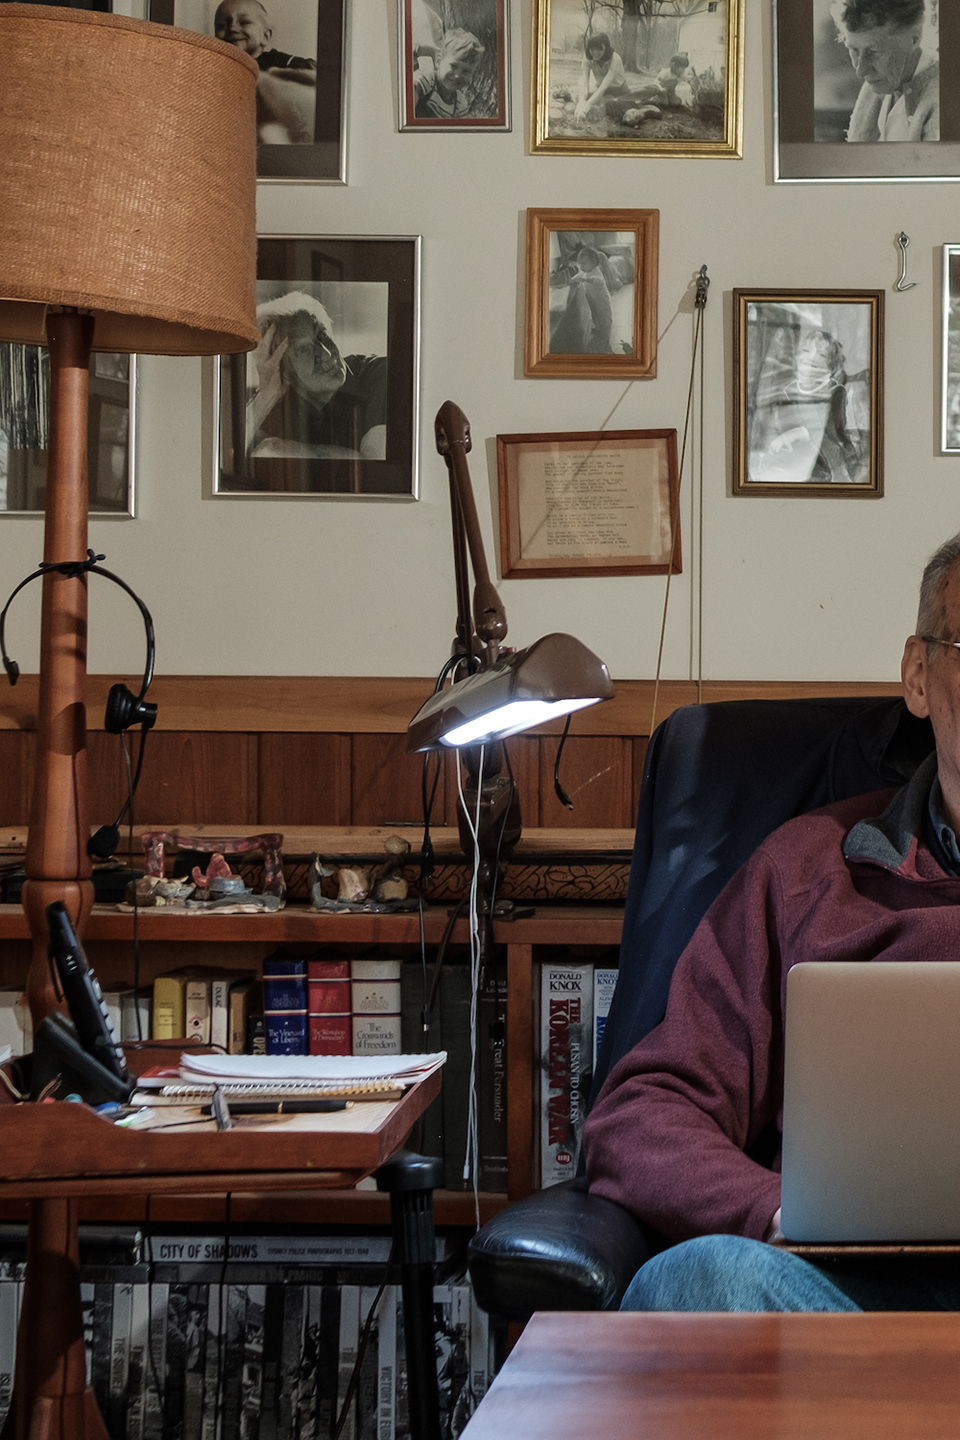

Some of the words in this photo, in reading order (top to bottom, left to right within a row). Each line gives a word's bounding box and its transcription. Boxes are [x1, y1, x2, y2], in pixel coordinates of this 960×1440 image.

[549, 981, 582, 991] KNOX
[570, 997, 581, 1024] THE
[268, 1029, 279, 1037] The
[279, 1028, 305, 1039] Vineyard
[356, 1031, 394, 1040] Crosswinds
[367, 1023, 382, 1032] The
[355, 1040, 363, 1049] of
[363, 1040, 397, 1049] Freedom
[548, 998, 570, 1088] KOREAN
[570, 1042, 580, 1073] PUSAN
[570, 1075, 580, 1088] TO
[493, 1071, 505, 1123] Persuader
[570, 1091, 580, 1124] CHOSIN
[548, 1094, 569, 1146] WAR
[160, 1244, 184, 1259] CITY
[187, 1244, 201, 1259] OF
[204, 1244, 259, 1259] SHADOWS
[114, 1338, 126, 1355] THE
[380, 1366, 392, 1404] VICTORY
[473, 1369, 485, 1387] THE
[380, 1407, 391, 1418] IN
